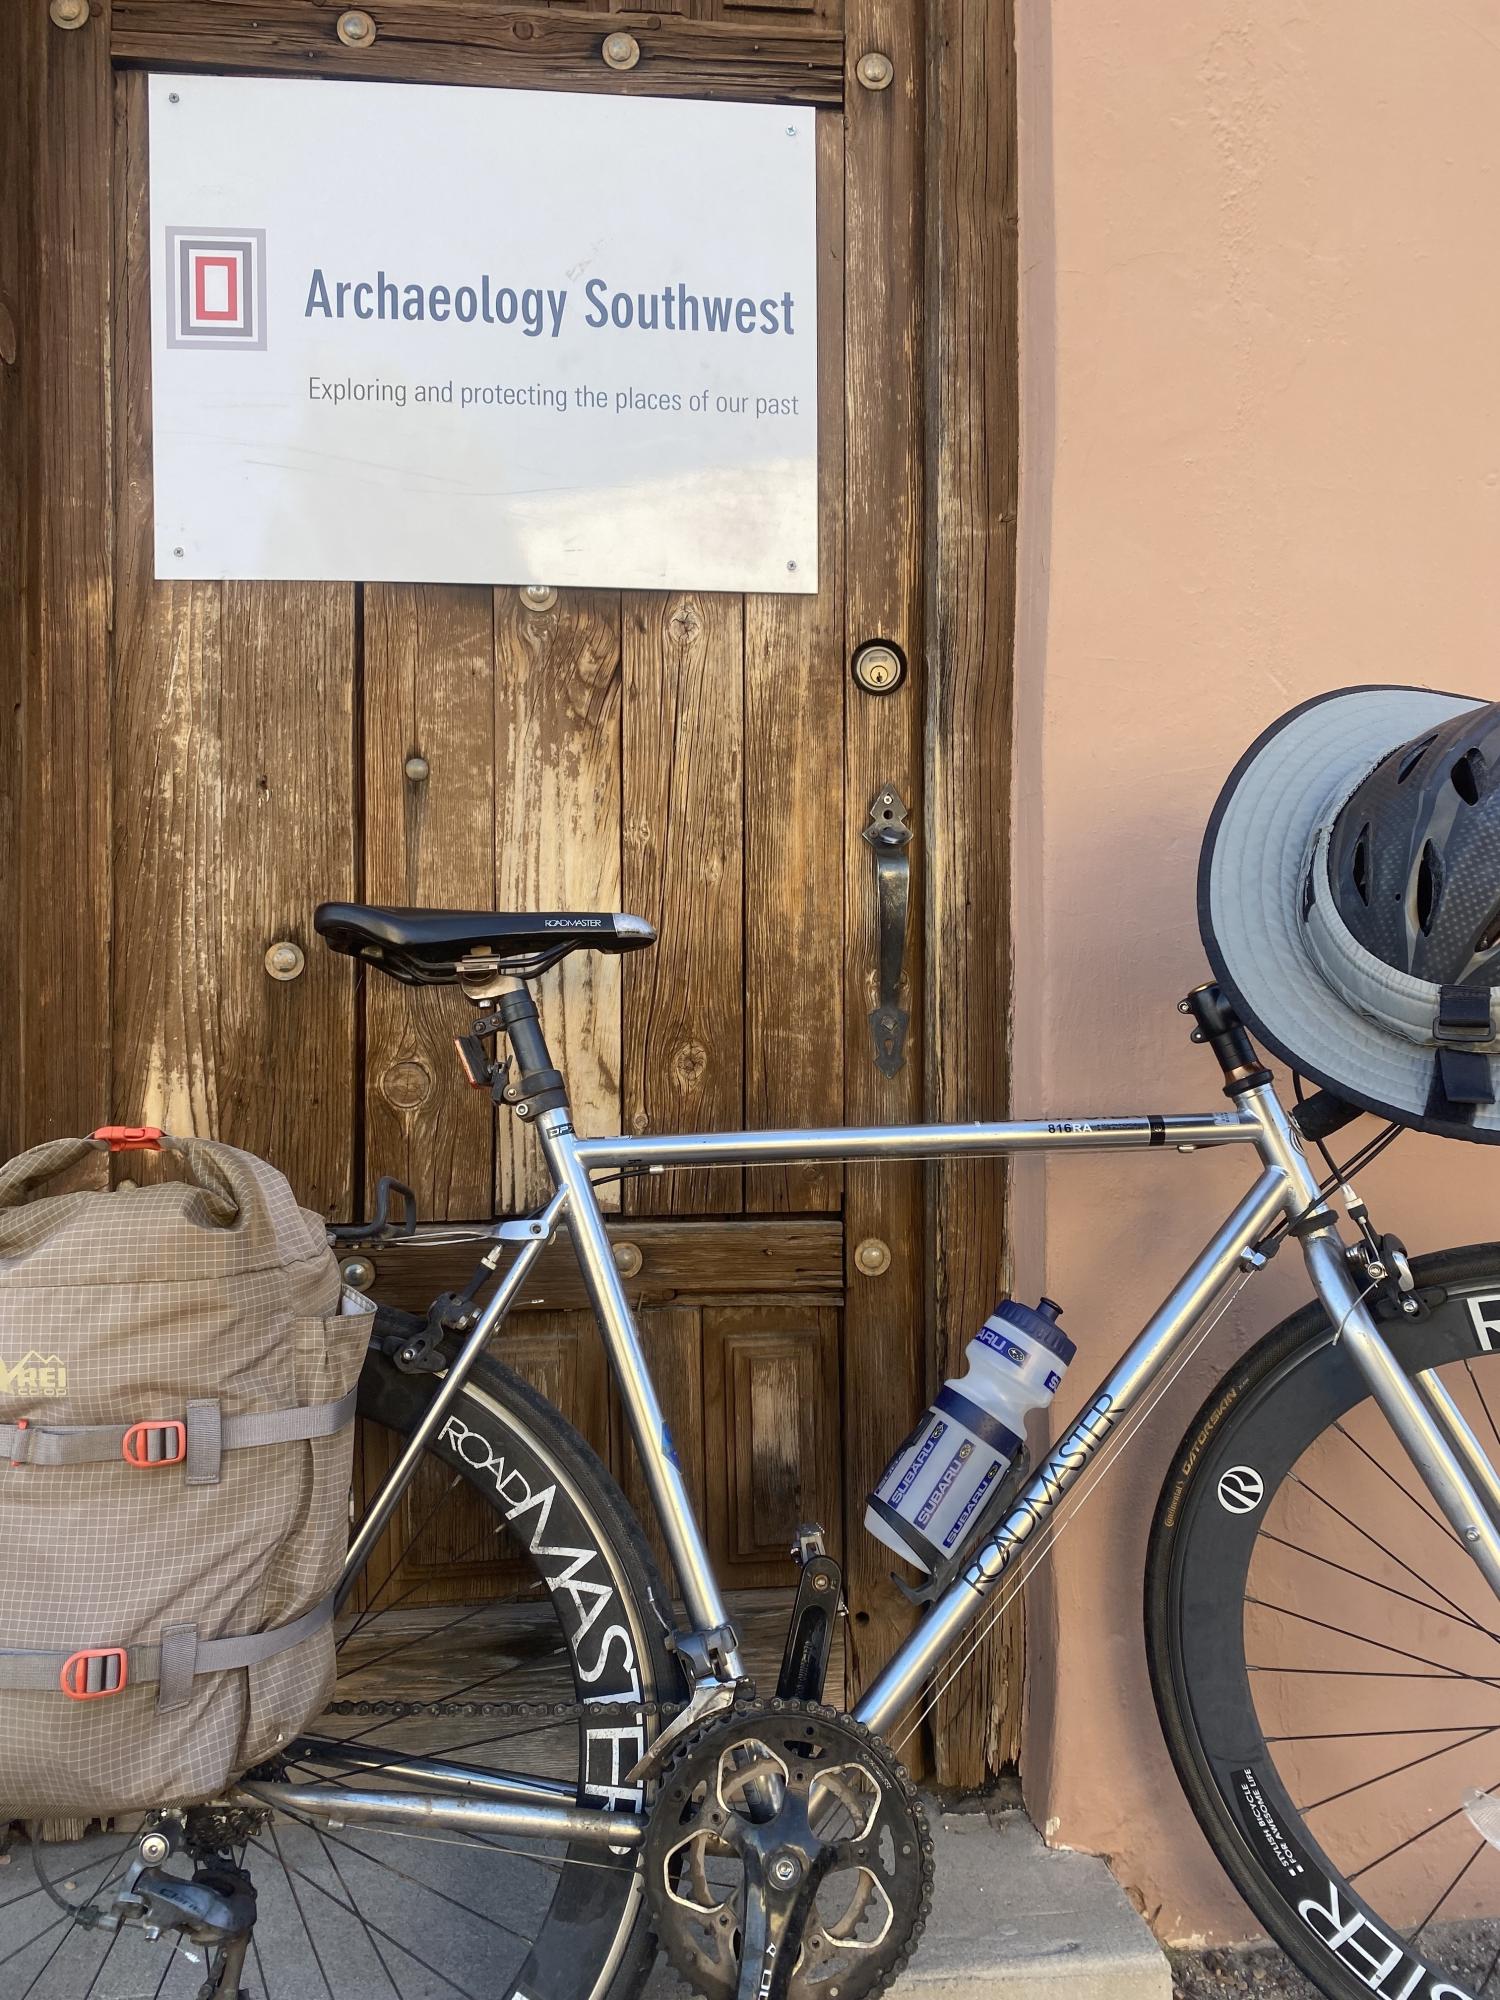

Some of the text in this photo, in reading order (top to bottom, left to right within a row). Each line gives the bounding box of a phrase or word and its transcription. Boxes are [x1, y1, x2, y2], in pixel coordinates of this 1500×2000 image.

[305, 269, 795, 337] Archaeology Southwest
[309, 376, 799, 419] Exploring and protecting the places of our past
[544, 919, 602, 927] ROADMASTER
[1048, 1122, 1093, 1134] 816RA
[17, 1367, 67, 1388] REI
[890, 1437, 935, 1505] SUBARU
[917, 1458, 963, 1525] SUBARU
[962, 1393, 1126, 1597] ROADMASTER
[946, 1480, 988, 1545] SUBARU
[1241, 1783, 1290, 1867] STYLISH BICYCLE
[1244, 1768, 1297, 1864] FOR AWESOME LIFE
